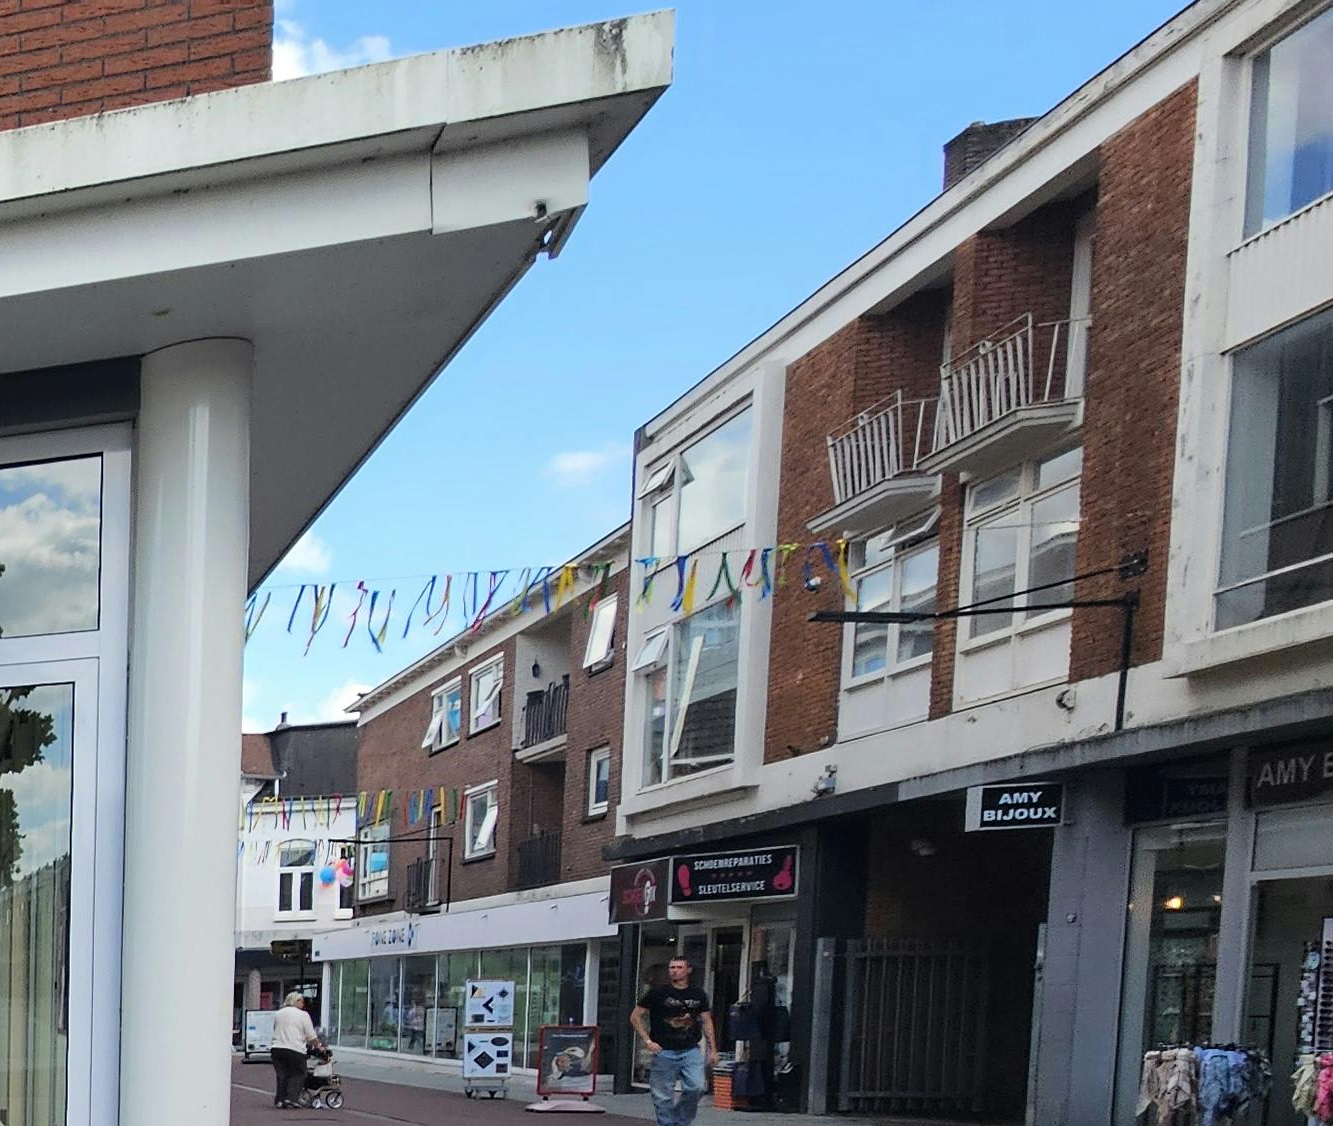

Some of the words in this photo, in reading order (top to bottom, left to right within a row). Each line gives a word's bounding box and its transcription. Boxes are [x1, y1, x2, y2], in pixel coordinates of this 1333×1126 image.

[1255, 752, 1319, 789] AMY
[999, 791, 1043, 805] AMY
[983, 806, 1057, 821] BIJOUX
[698, 880, 766, 896] SLEUTELSERVICE
